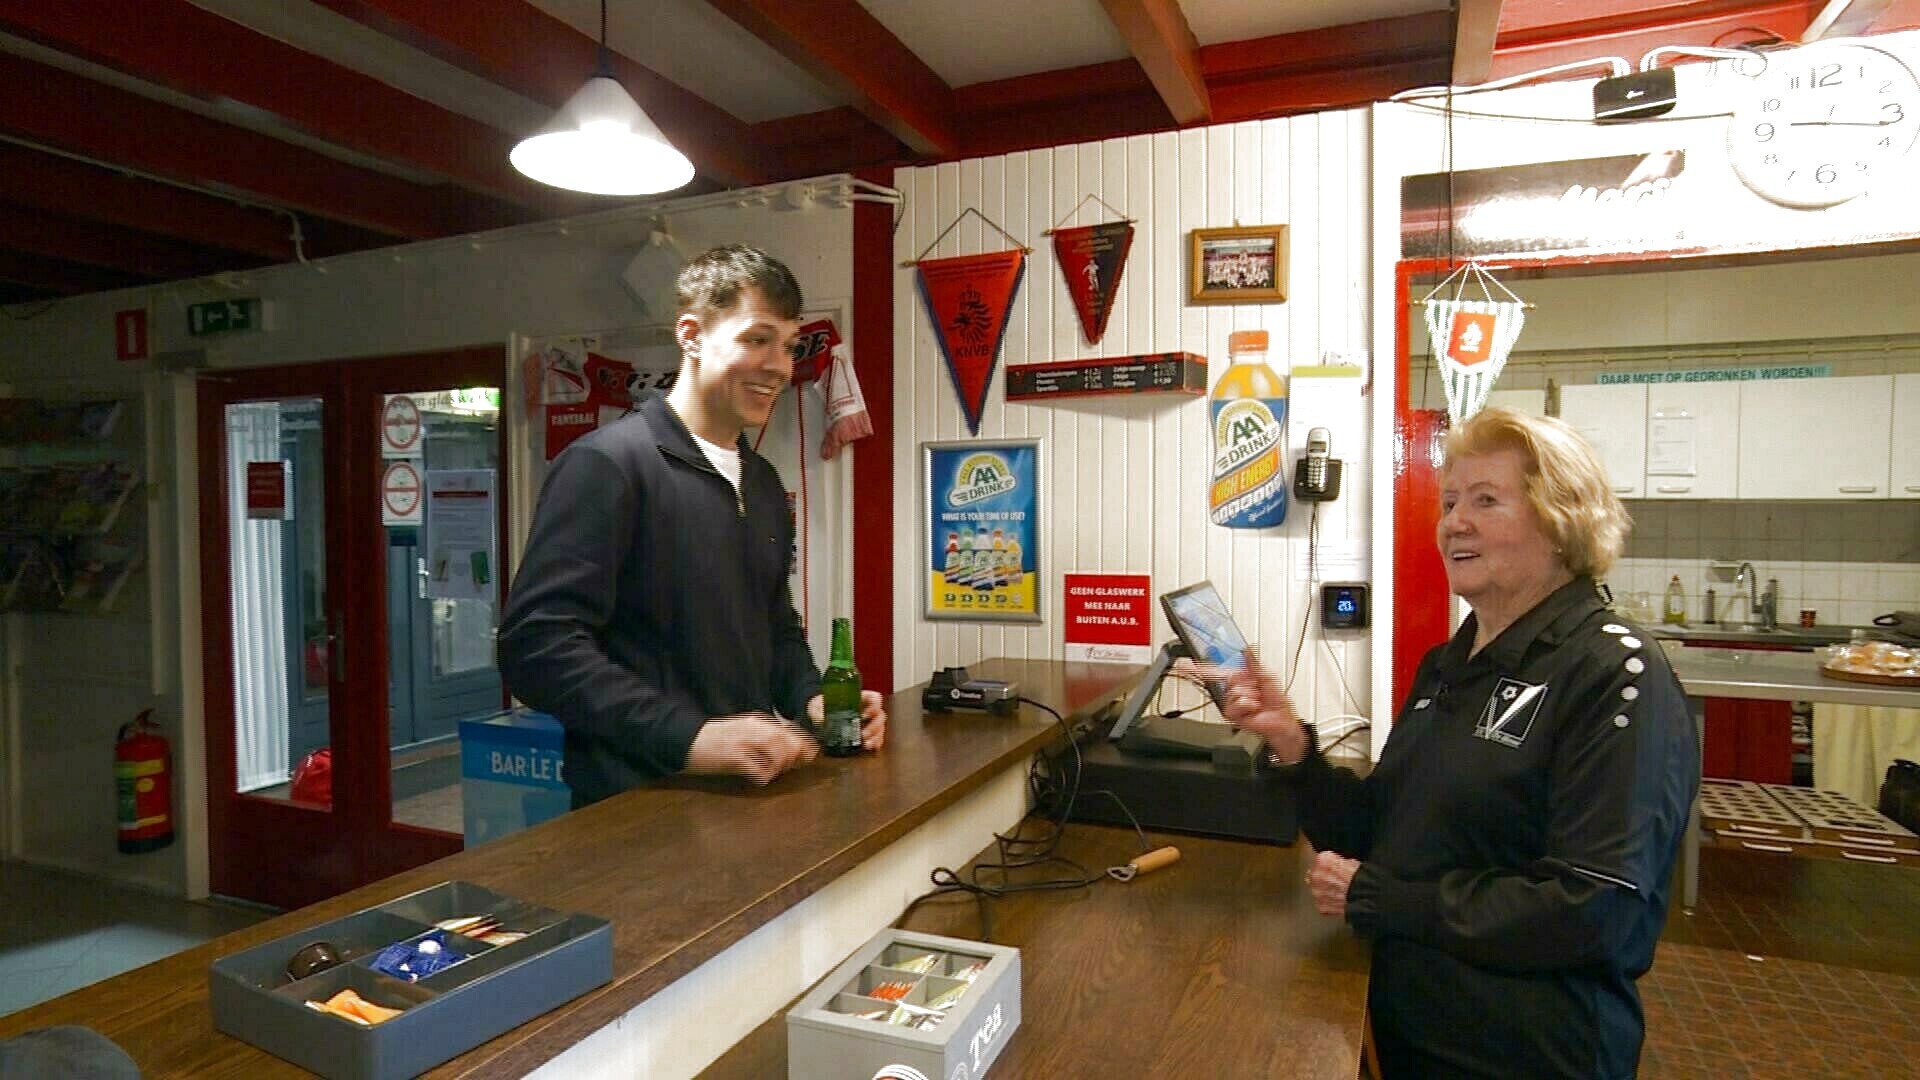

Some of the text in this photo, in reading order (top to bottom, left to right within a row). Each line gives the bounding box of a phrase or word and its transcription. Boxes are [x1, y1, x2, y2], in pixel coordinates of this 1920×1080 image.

[1790, 76, 1799, 90] 11
[1810, 63, 1842, 88] 12
[1763, 98, 1781, 113] 10
[1881, 103, 1904, 125] 3
[1754, 122, 1775, 143] 9
[1815, 163, 1837, 184] 6
[955, 344, 990, 358] KNVB
[1601, 374, 1630, 385] DAAR
[1632, 372, 1664, 384] MOET
[1665, 371, 1682, 383] OP
[1684, 369, 1756, 382] GEDRONKEN
[1232, 416, 1264, 447] AA
[1228, 433, 1271, 464] DRINK
[974, 466, 999, 487] AA
[969, 481, 1005, 500] DRINK
[1070, 586, 1145, 597] GEEN GLASWERK
[1083, 601, 1131, 611] MEE NAAR
[1076, 615, 1110, 625] BUITEN
[968, 1001, 1002, 1073] Tea
